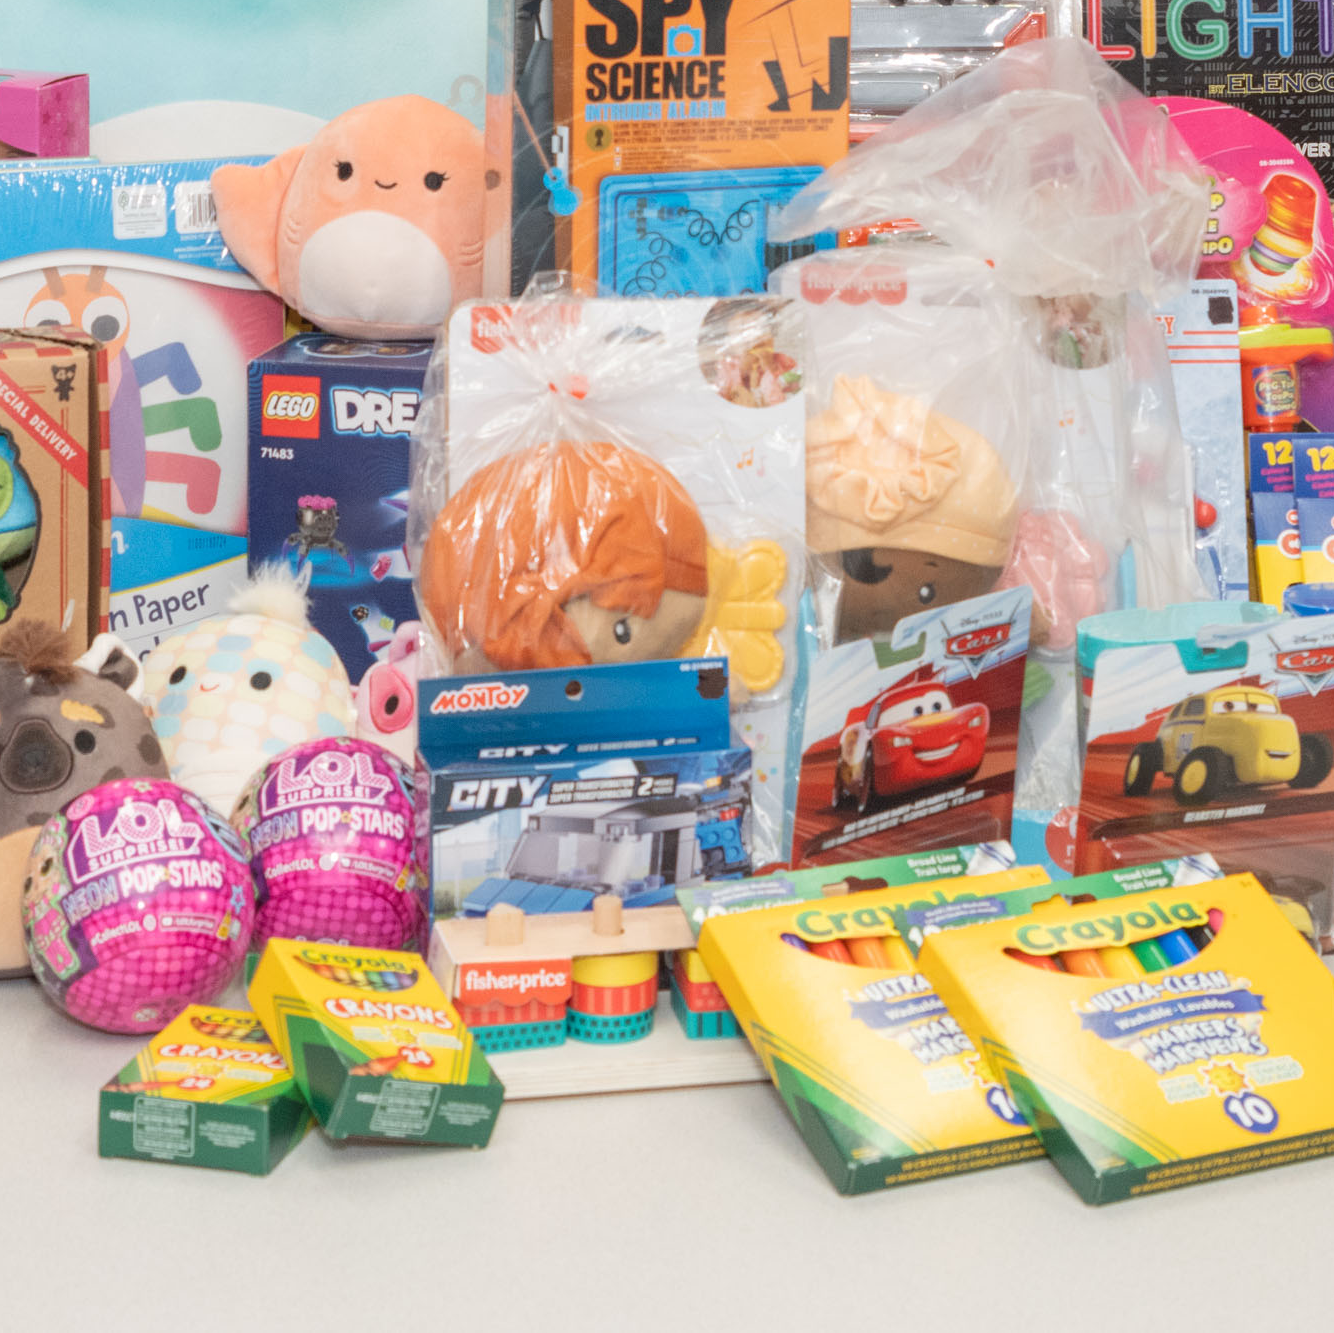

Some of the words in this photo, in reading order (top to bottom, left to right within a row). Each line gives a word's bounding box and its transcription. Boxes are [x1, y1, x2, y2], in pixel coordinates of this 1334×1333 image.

[585, 60, 725, 102] SCIENCE
[1209, 85, 1225, 94] BY
[585, 102, 662, 122] INTRUDER
[667, 100, 726, 120] ALARM
[55, 370, 75, 379] 4+
[265, 394, 315, 418] LEGO
[334, 389, 419, 434] DRE
[27, 413, 77, 462] DELIVERY
[260, 447, 295, 460] 71483
[1262, 440, 1293, 466] 12
[134, 582, 211, 623] Paper
[951, 630, 1003, 653] Cars
[433, 685, 528, 712] MONTOY
[479, 743, 569, 759] CITY
[277, 786, 370, 806] SURPRISE!
[447, 776, 549, 812] CITY
[637, 777, 653, 796] 2
[301, 806, 341, 834] POP
[351, 806, 405, 840] STARS
[89, 838, 185, 872] SURPRISE!
[119, 865, 159, 898] POP
[168, 859, 223, 888] STARS
[1017, 902, 1202, 950] Crayola
[300, 948, 407, 972] Crayola
[465, 968, 567, 992] fisher-price
[867, 974, 932, 1001] ULTRA
[1093, 972, 1231, 1011] ULTRA-CLEAN
[325, 998, 453, 1030] CRAYONS
[1115, 1004, 1172, 1030] Washable
[1143, 1018, 1246, 1053] MARKERS
[160, 1044, 287, 1070] CRAYONS
[403, 1047, 429, 1066] 24
[1141, 1034, 1268, 1073] MARQUEURS
[179, 1076, 206, 1089] 24
[1229, 1094, 1275, 1132] 10
